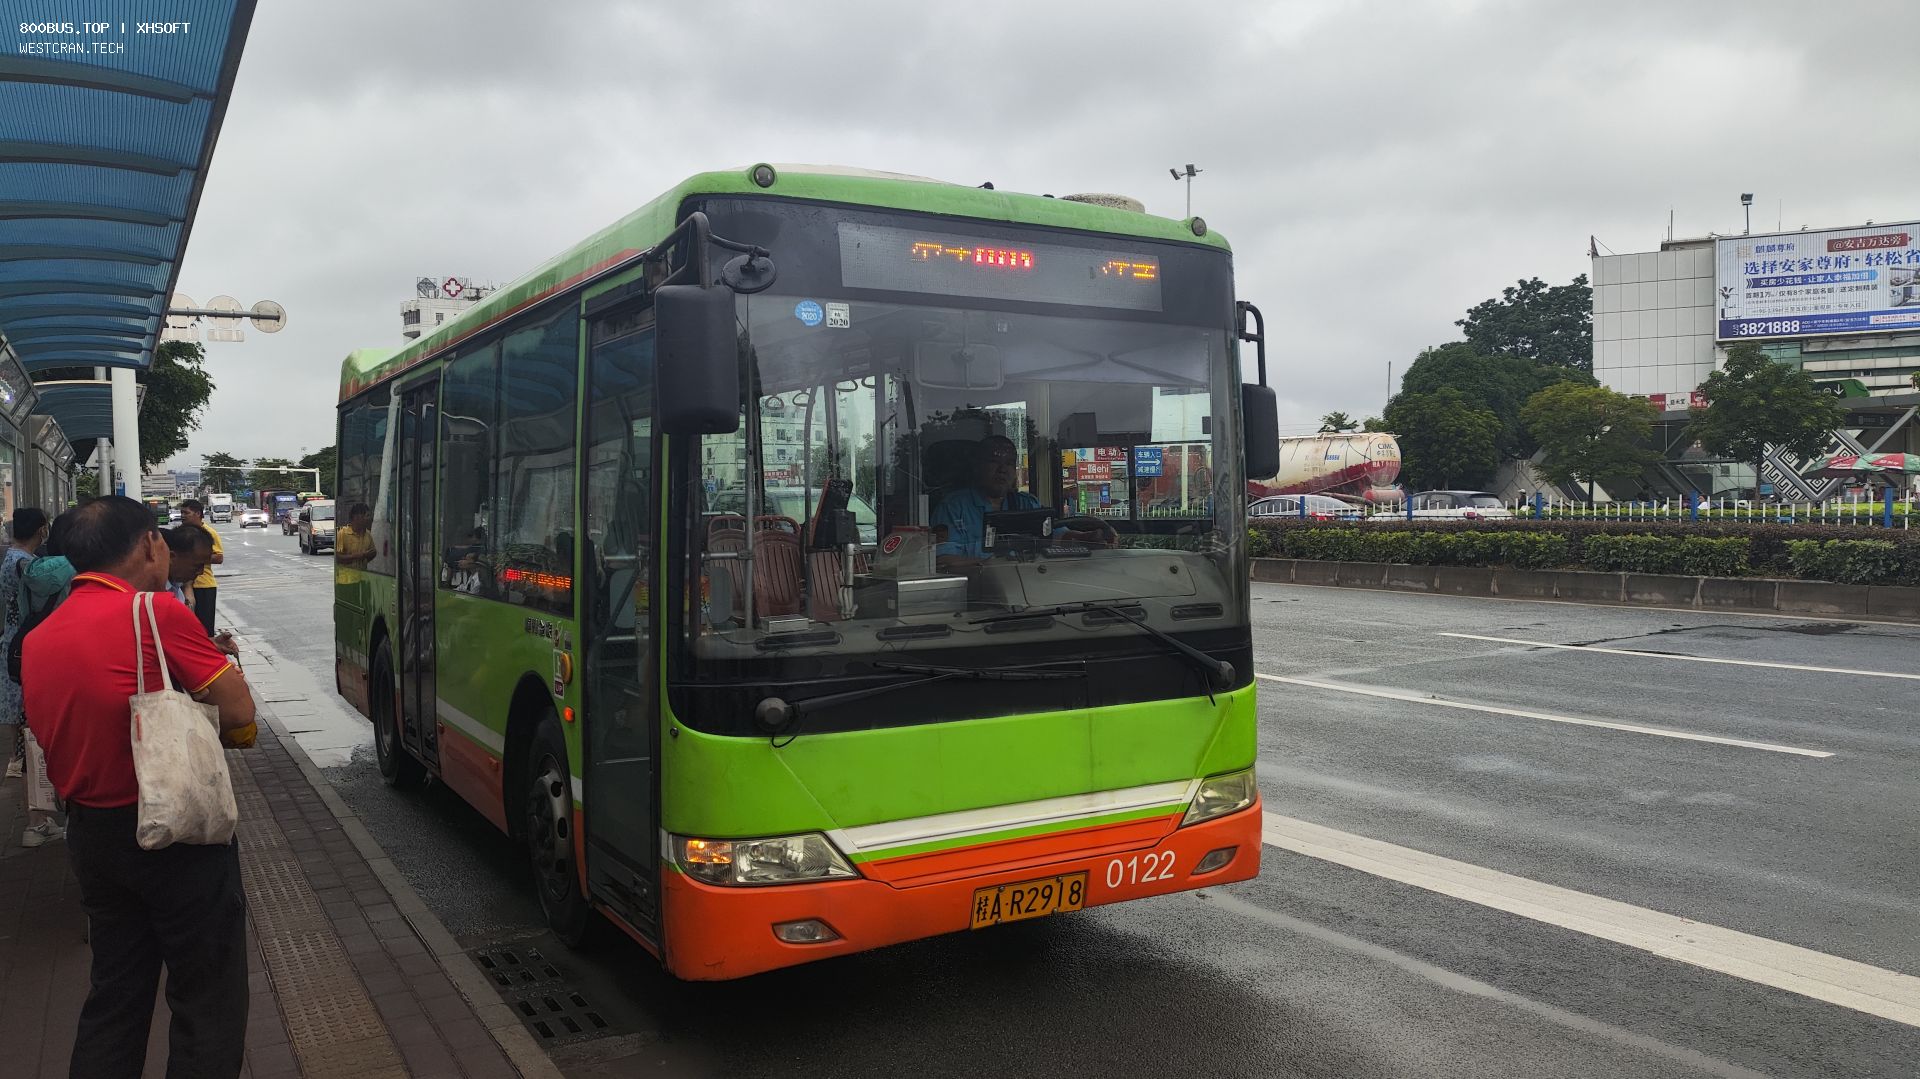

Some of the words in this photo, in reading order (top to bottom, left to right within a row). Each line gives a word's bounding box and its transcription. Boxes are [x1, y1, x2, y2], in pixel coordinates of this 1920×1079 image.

[801, 312, 818, 321] 2020
[829, 318, 848, 326] 2020
[1739, 320, 1800, 336] 3821888
[1106, 850, 1176, 889] 0122
